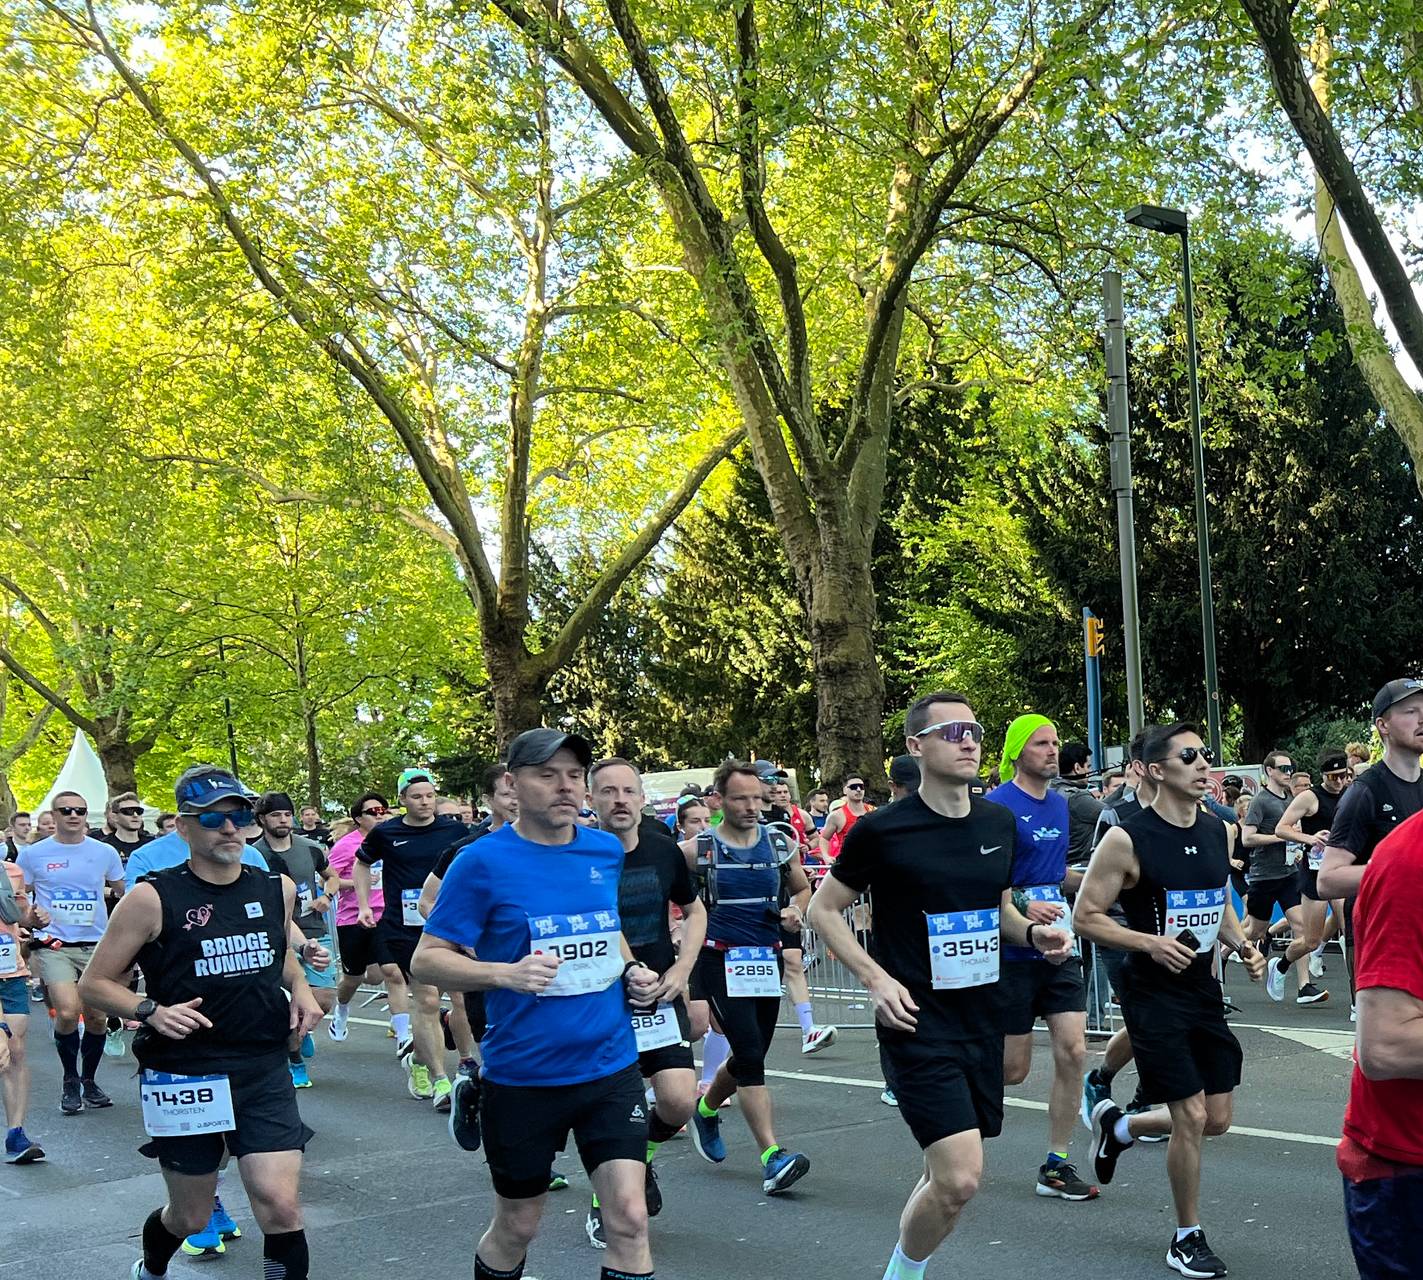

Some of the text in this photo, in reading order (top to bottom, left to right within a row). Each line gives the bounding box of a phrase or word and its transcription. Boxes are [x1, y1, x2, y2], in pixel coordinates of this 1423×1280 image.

[47, 859, 70, 873] pod
[59, 903, 93, 911] 4700
[534, 916, 552, 927] uni
[566, 914, 583, 925] uni
[594, 911, 610, 922] uni
[1176, 912, 1219, 928] 5000
[572, 921, 589, 933] per
[599, 918, 616, 930] per
[540, 925, 559, 937] per
[201, 931, 271, 958] BRIDGE
[942, 936, 998, 957] 3543
[194, 949, 276, 977] RUNNERS
[734, 965, 774, 976] 2895
[152, 1088, 214, 1107] 1438
[162, 1107, 206, 1117] THORSTEN
